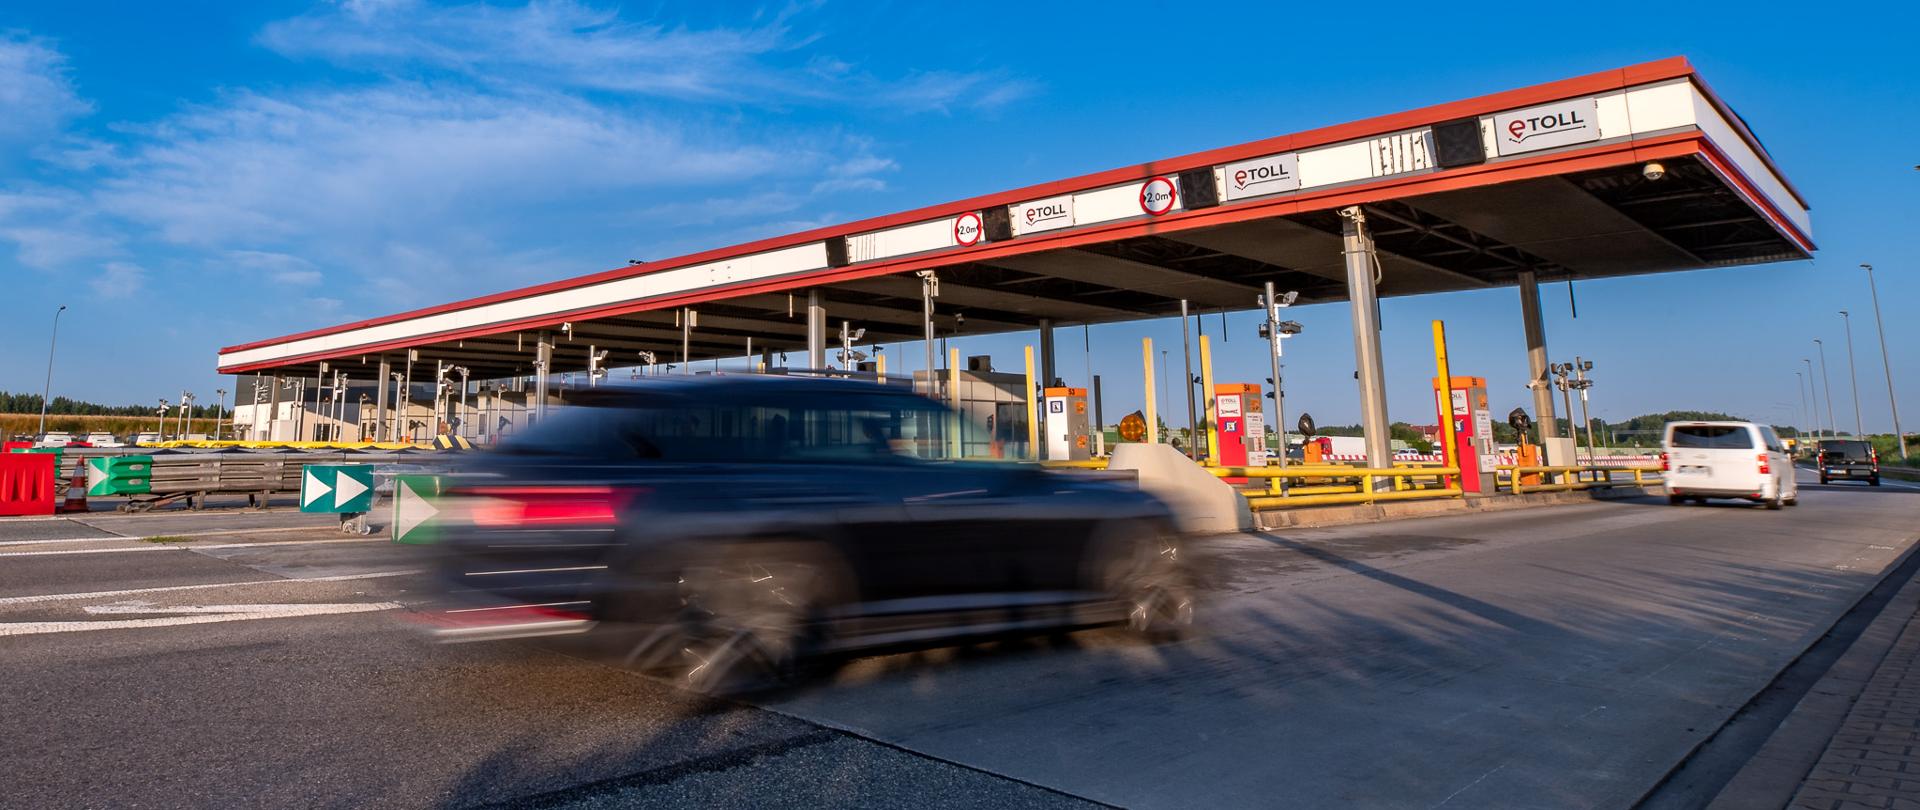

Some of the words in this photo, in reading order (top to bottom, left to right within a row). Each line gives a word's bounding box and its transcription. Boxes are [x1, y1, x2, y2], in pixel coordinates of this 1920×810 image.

[1509, 111, 1584, 138] eTOLL
[1235, 164, 1288, 186] eTOLL
[1026, 204, 1066, 222] eTOLL
